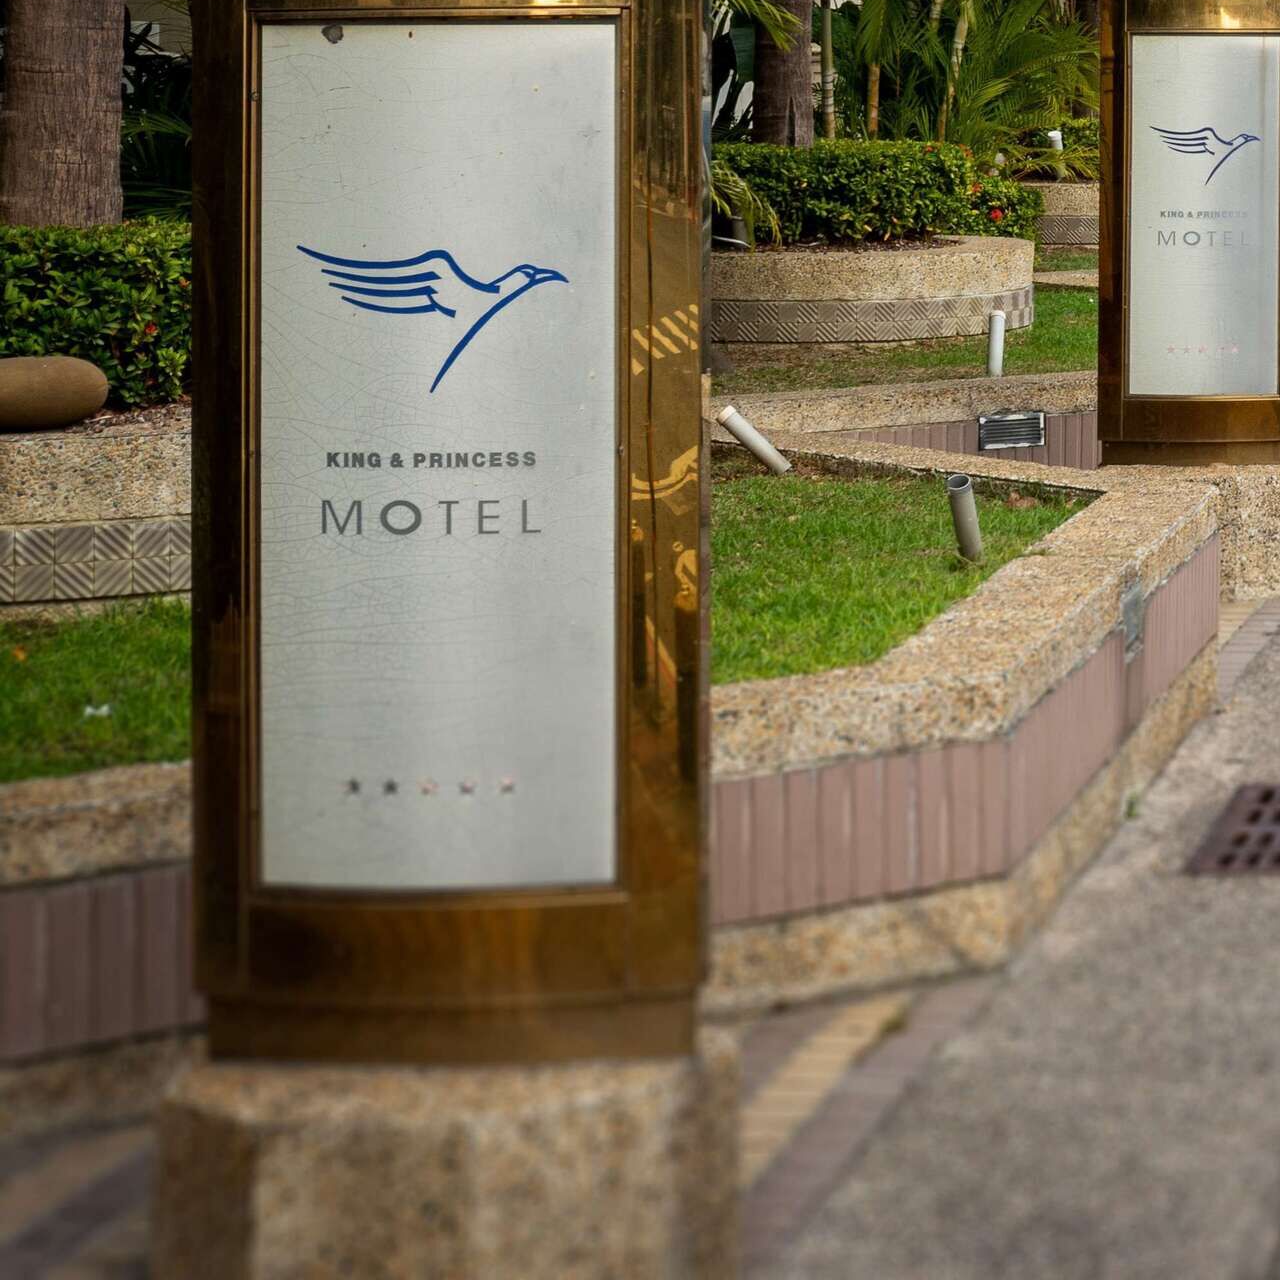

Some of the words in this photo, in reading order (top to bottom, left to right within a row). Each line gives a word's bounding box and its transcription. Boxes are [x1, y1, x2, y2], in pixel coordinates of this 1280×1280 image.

[1160, 210, 1184, 218] KING
[1187, 210, 1193, 218] &
[1157, 230, 1249, 246] MOTEL
[326, 451, 382, 469] KING
[390, 452, 404, 469] &
[413, 451, 538, 469] PRINCESS
[320, 498, 542, 536] MOTEL
